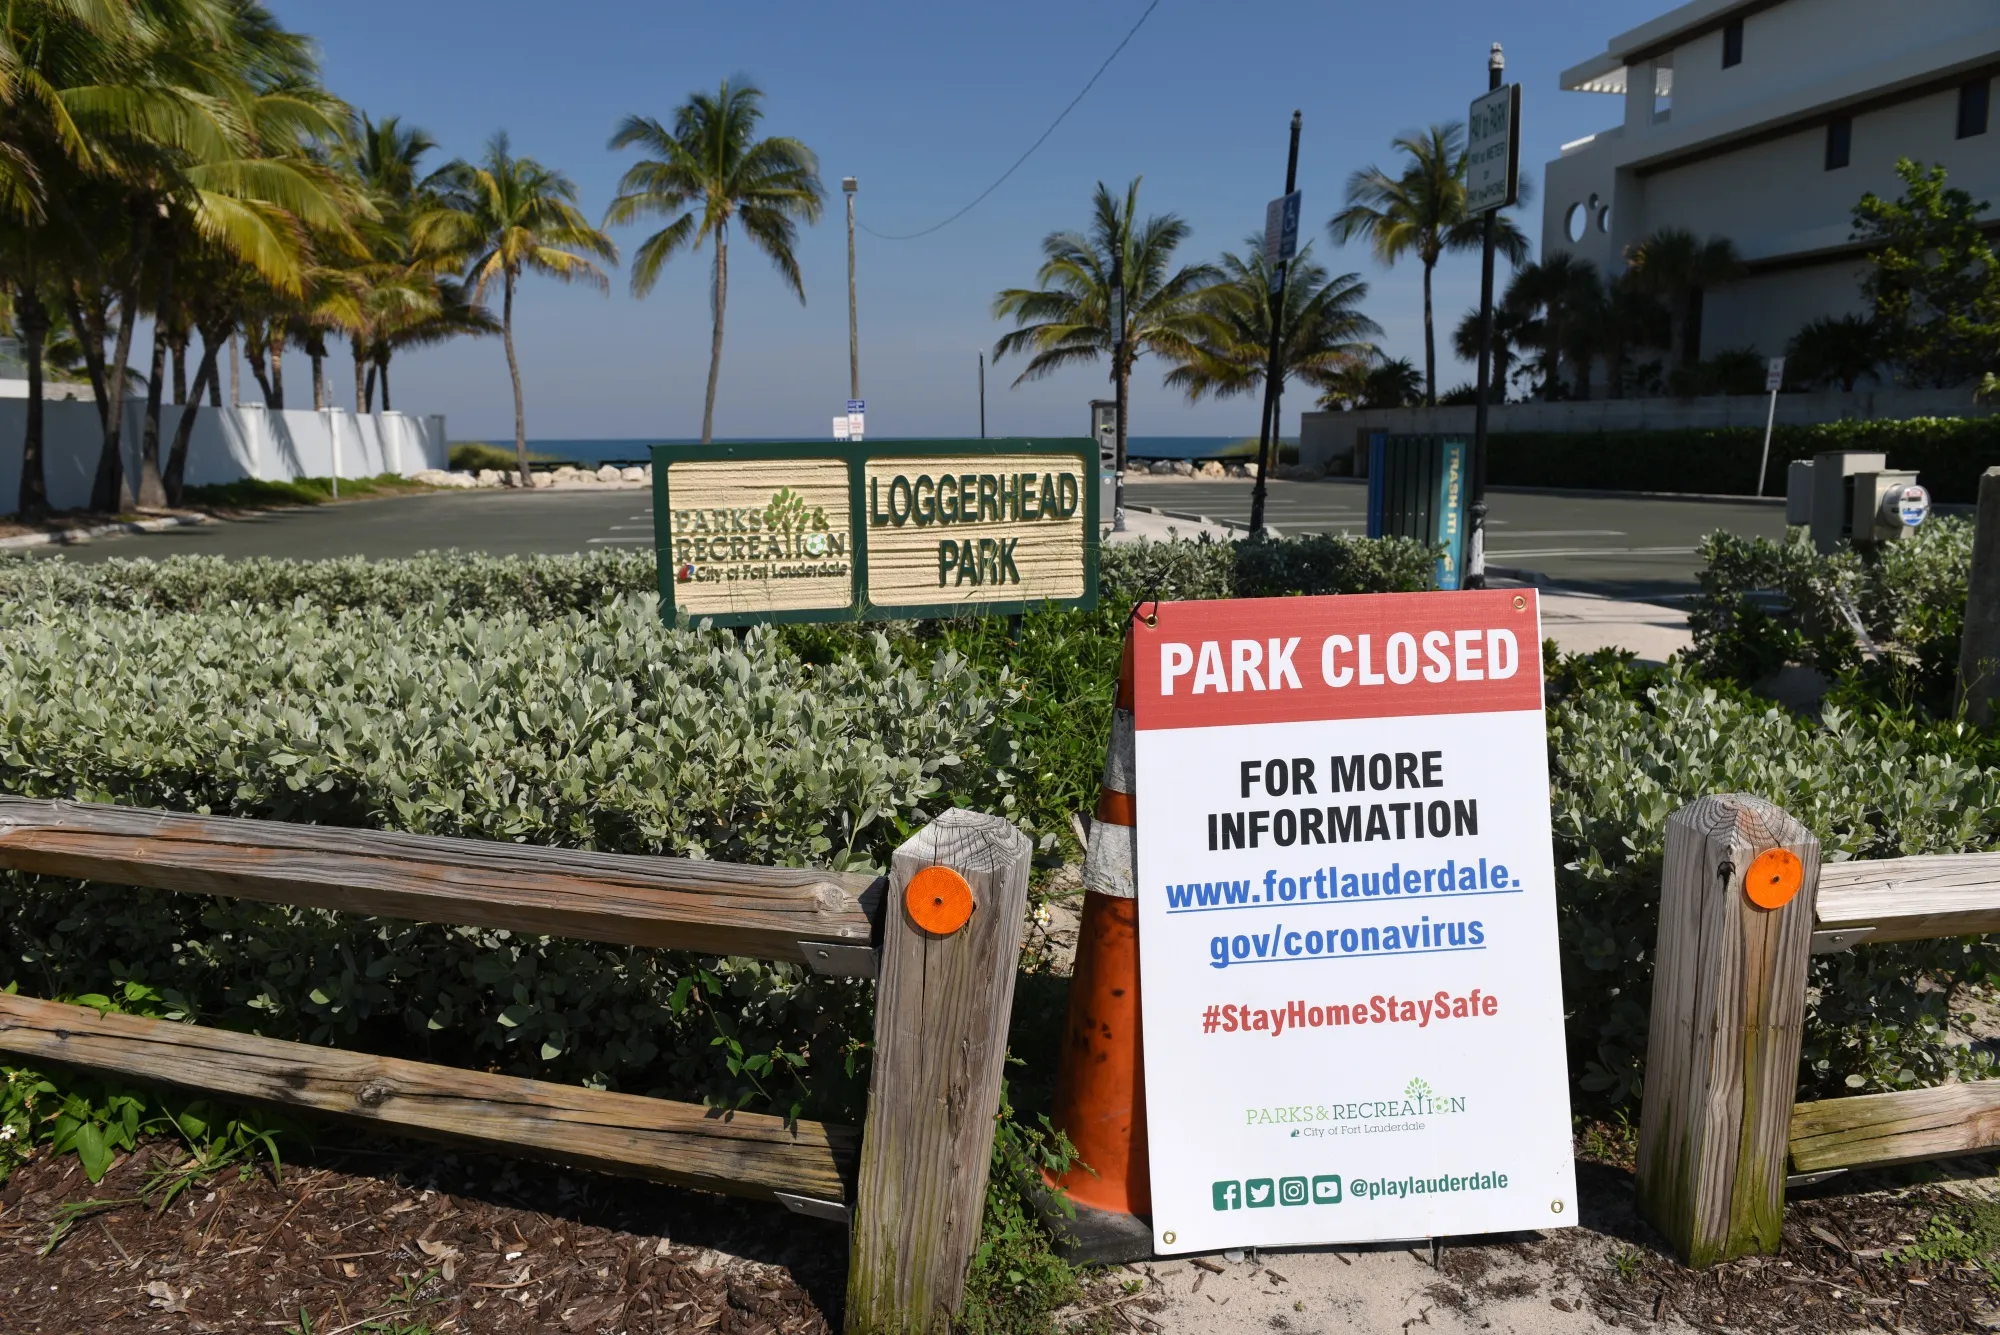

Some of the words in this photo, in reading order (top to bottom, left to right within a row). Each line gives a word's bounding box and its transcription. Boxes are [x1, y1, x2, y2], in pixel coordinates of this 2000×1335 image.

[1487, 101, 1507, 136] PARK
[1486, 142, 1505, 160] METER
[871, 472, 1079, 527] LOGGERHEAD
[1448, 448, 1459, 508] TRASH
[675, 508, 763, 533] PARKS
[676, 533, 846, 562] RECREATION
[939, 537, 1021, 588] PARK
[696, 566, 724, 583] City
[727, 564, 740, 581] of
[743, 564, 769, 580] Fort
[772, 561, 848, 579] Lauderdale
[1160, 637, 1303, 697] PARK
[1321, 628, 1520, 688] CLOSED
[1240, 757, 1318, 799] FOR
[1330, 750, 1444, 793] MORE
[1207, 798, 1479, 852] INFORMATION
[1165, 857, 1522, 909] www.fortlauderdale.
[1210, 915, 1486, 969] gov/coronavirus
[1202, 989, 1499, 1037] #StayHomeStaySafe
[1303, 1126, 1326, 1139] City
[1327, 1125, 1339, 1136] of
[1341, 1123, 1362, 1135] Fort
[1364, 1121, 1426, 1134] Lauderdale
[1350, 1171, 1509, 1201] @playlauderdale
